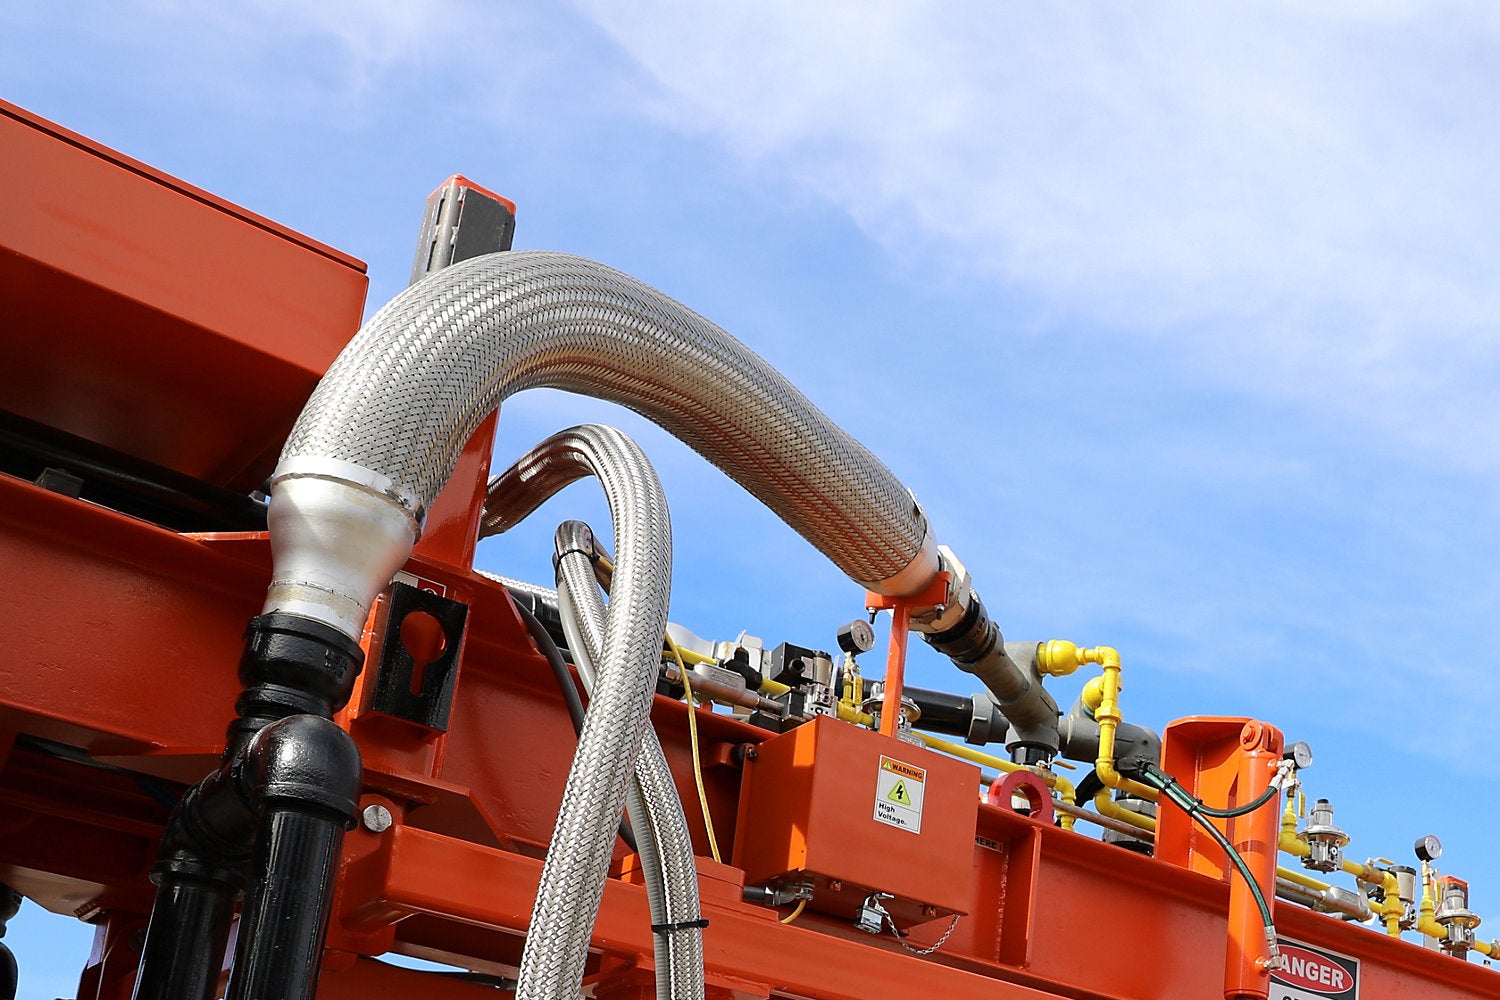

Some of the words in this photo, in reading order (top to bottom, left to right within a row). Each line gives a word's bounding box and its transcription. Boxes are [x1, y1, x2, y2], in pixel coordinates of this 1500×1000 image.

[892, 763, 923, 779] WARNING
[878, 803, 895, 813] High
[878, 811, 907, 825] Voltage.
[1279, 953, 1344, 989] ANGER
